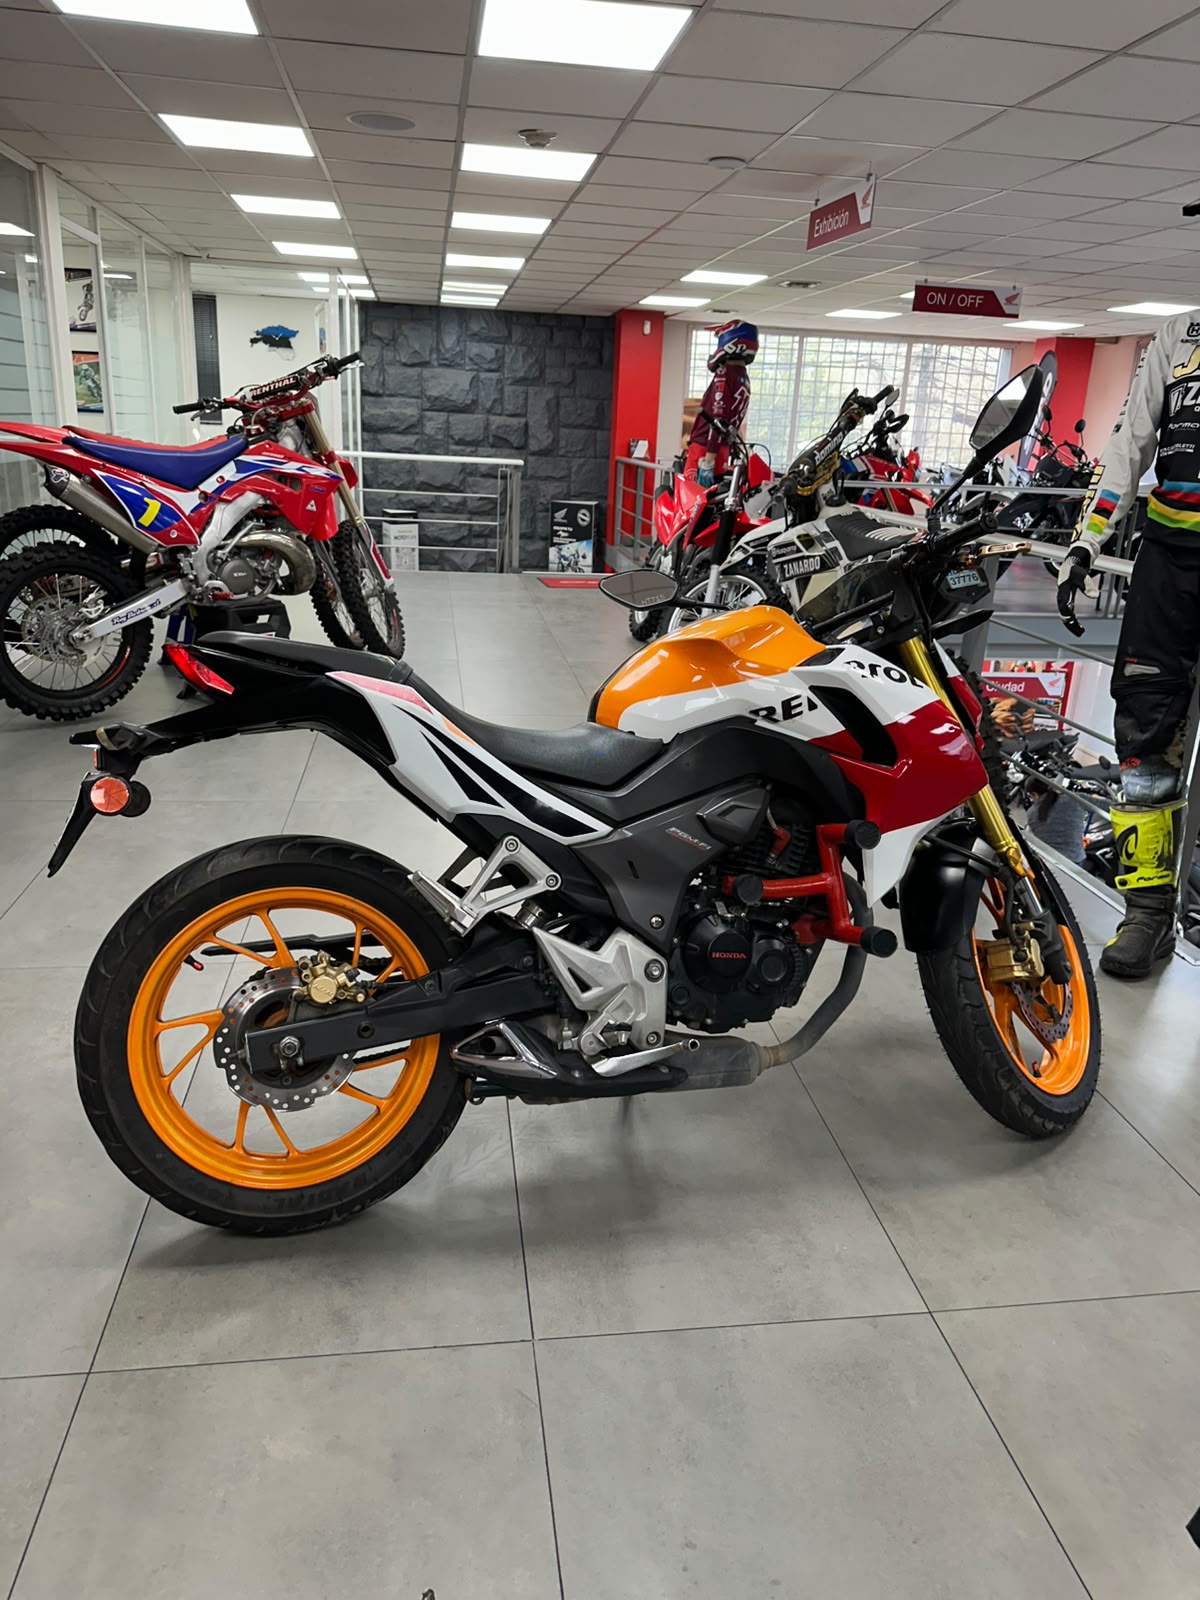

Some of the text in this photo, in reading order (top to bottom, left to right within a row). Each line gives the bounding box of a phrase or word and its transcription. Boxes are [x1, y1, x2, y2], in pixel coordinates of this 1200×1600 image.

[813, 207, 849, 238] Exhibición
[926, 291, 947, 305] ON
[957, 294, 984, 308] OFF
[250, 376, 297, 397] RENTHAL
[815, 431, 844, 465] domino
[138, 497, 161, 527] 1
[783, 556, 821, 578] ZANARDO
[949, 573, 979, 586] 37776
[711, 951, 747, 959] HONDA
